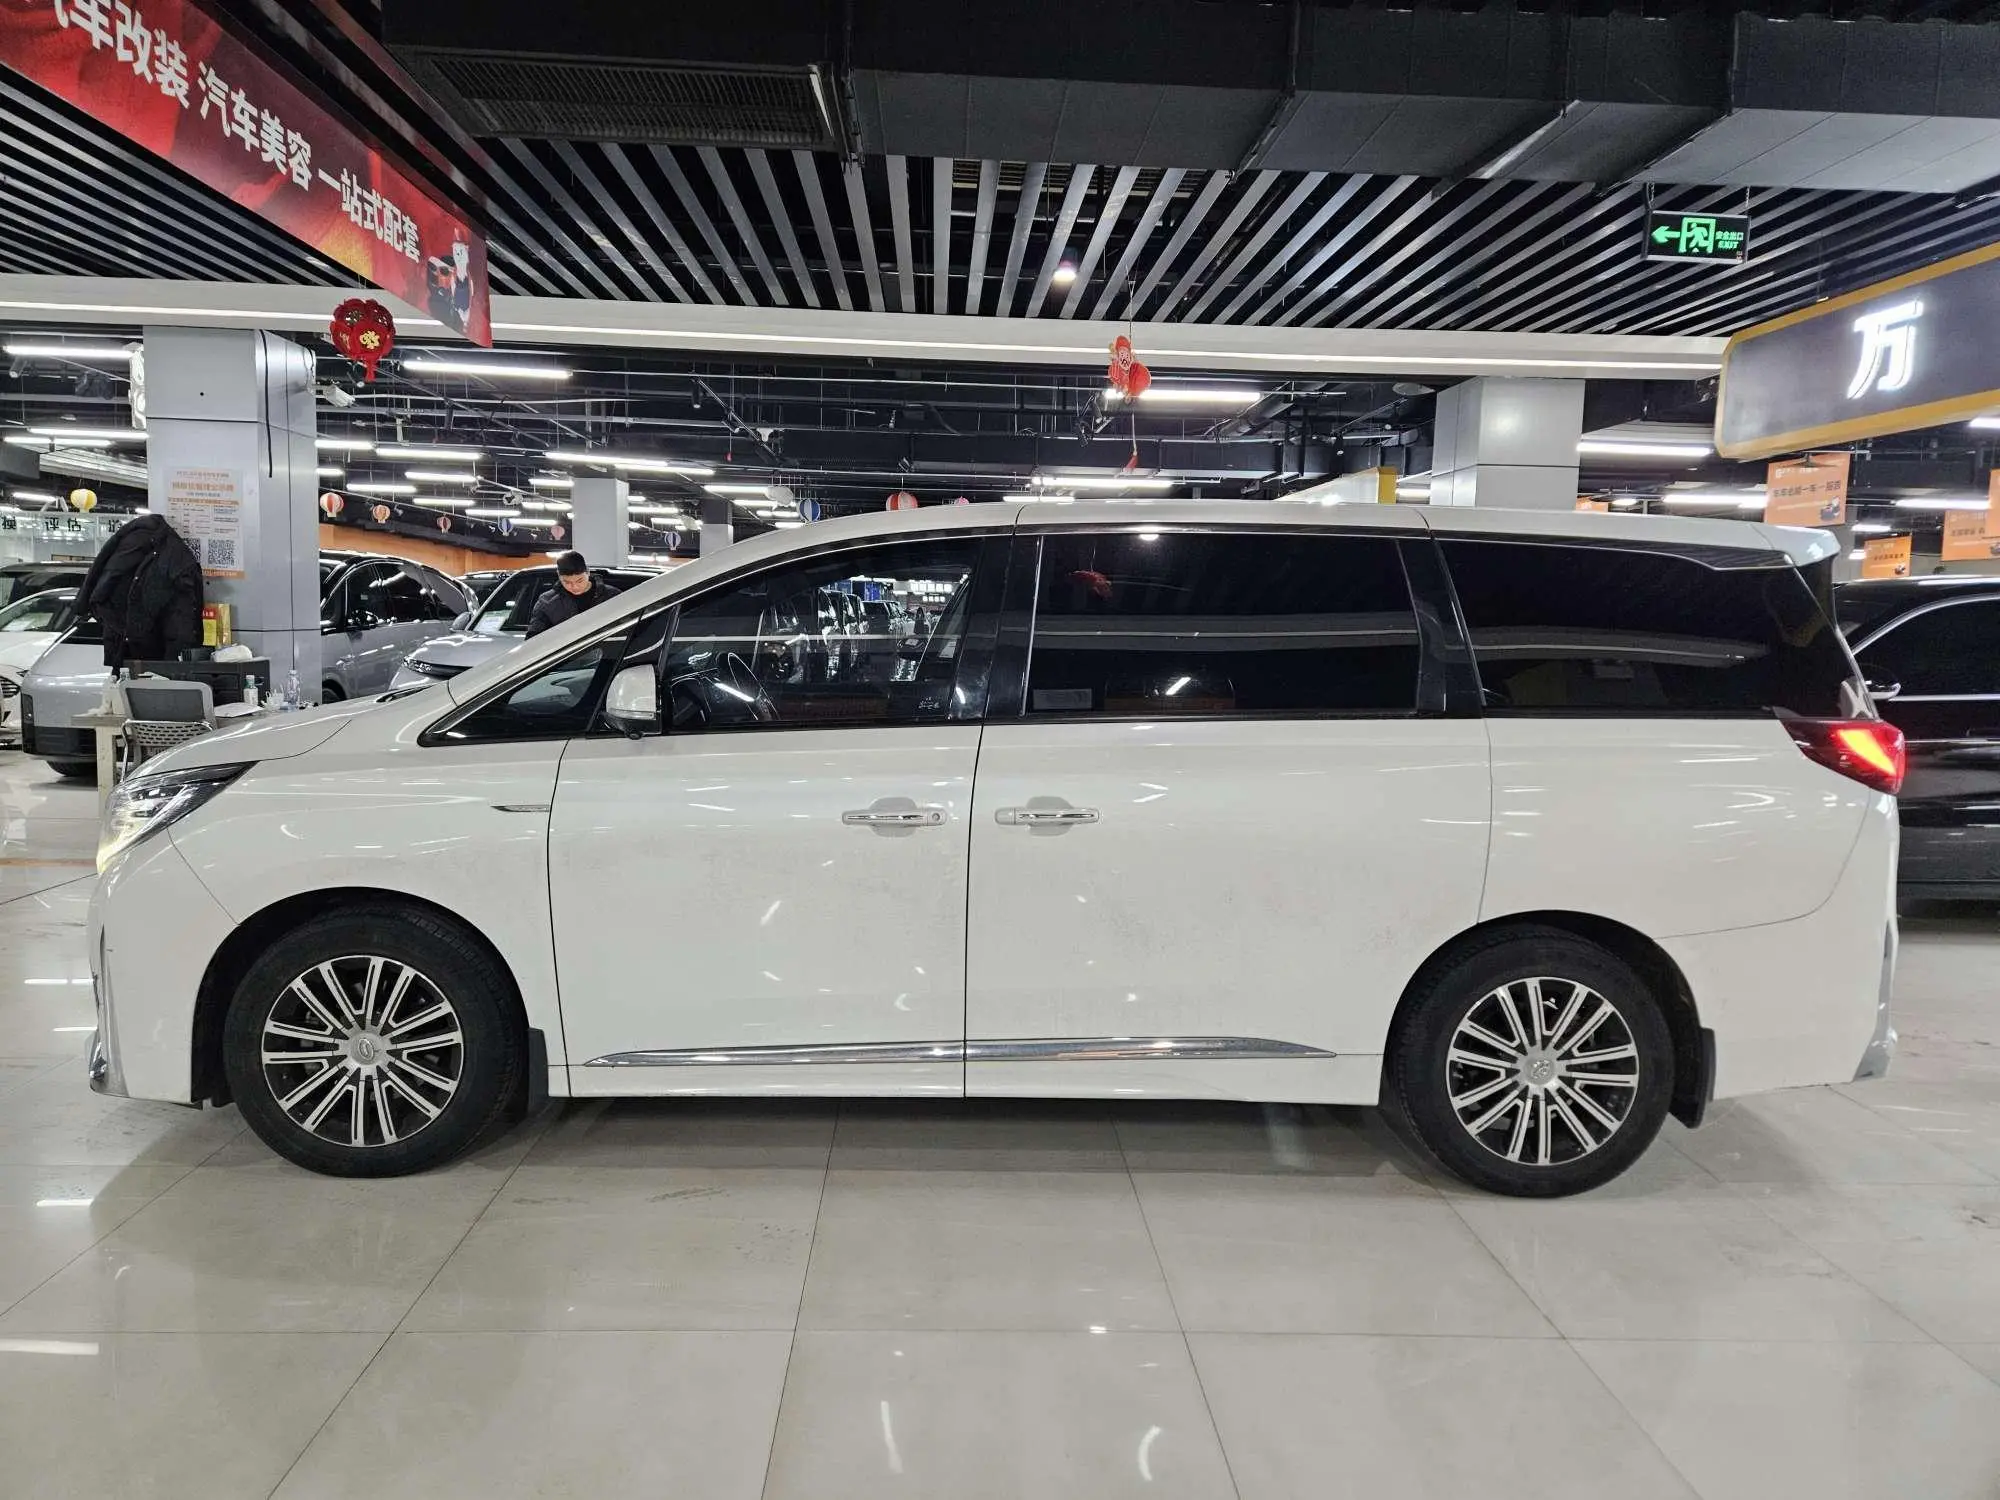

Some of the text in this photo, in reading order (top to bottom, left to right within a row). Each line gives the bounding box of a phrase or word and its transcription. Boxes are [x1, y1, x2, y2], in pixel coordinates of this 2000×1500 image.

[197, 62, 312, 191] 汽车美容
[318, 168, 420, 263] 一站式配套
[1718, 240, 1739, 249] EXIT
[1847, 298, 1924, 400] 万
[45, 517, 82, 532] 评估
